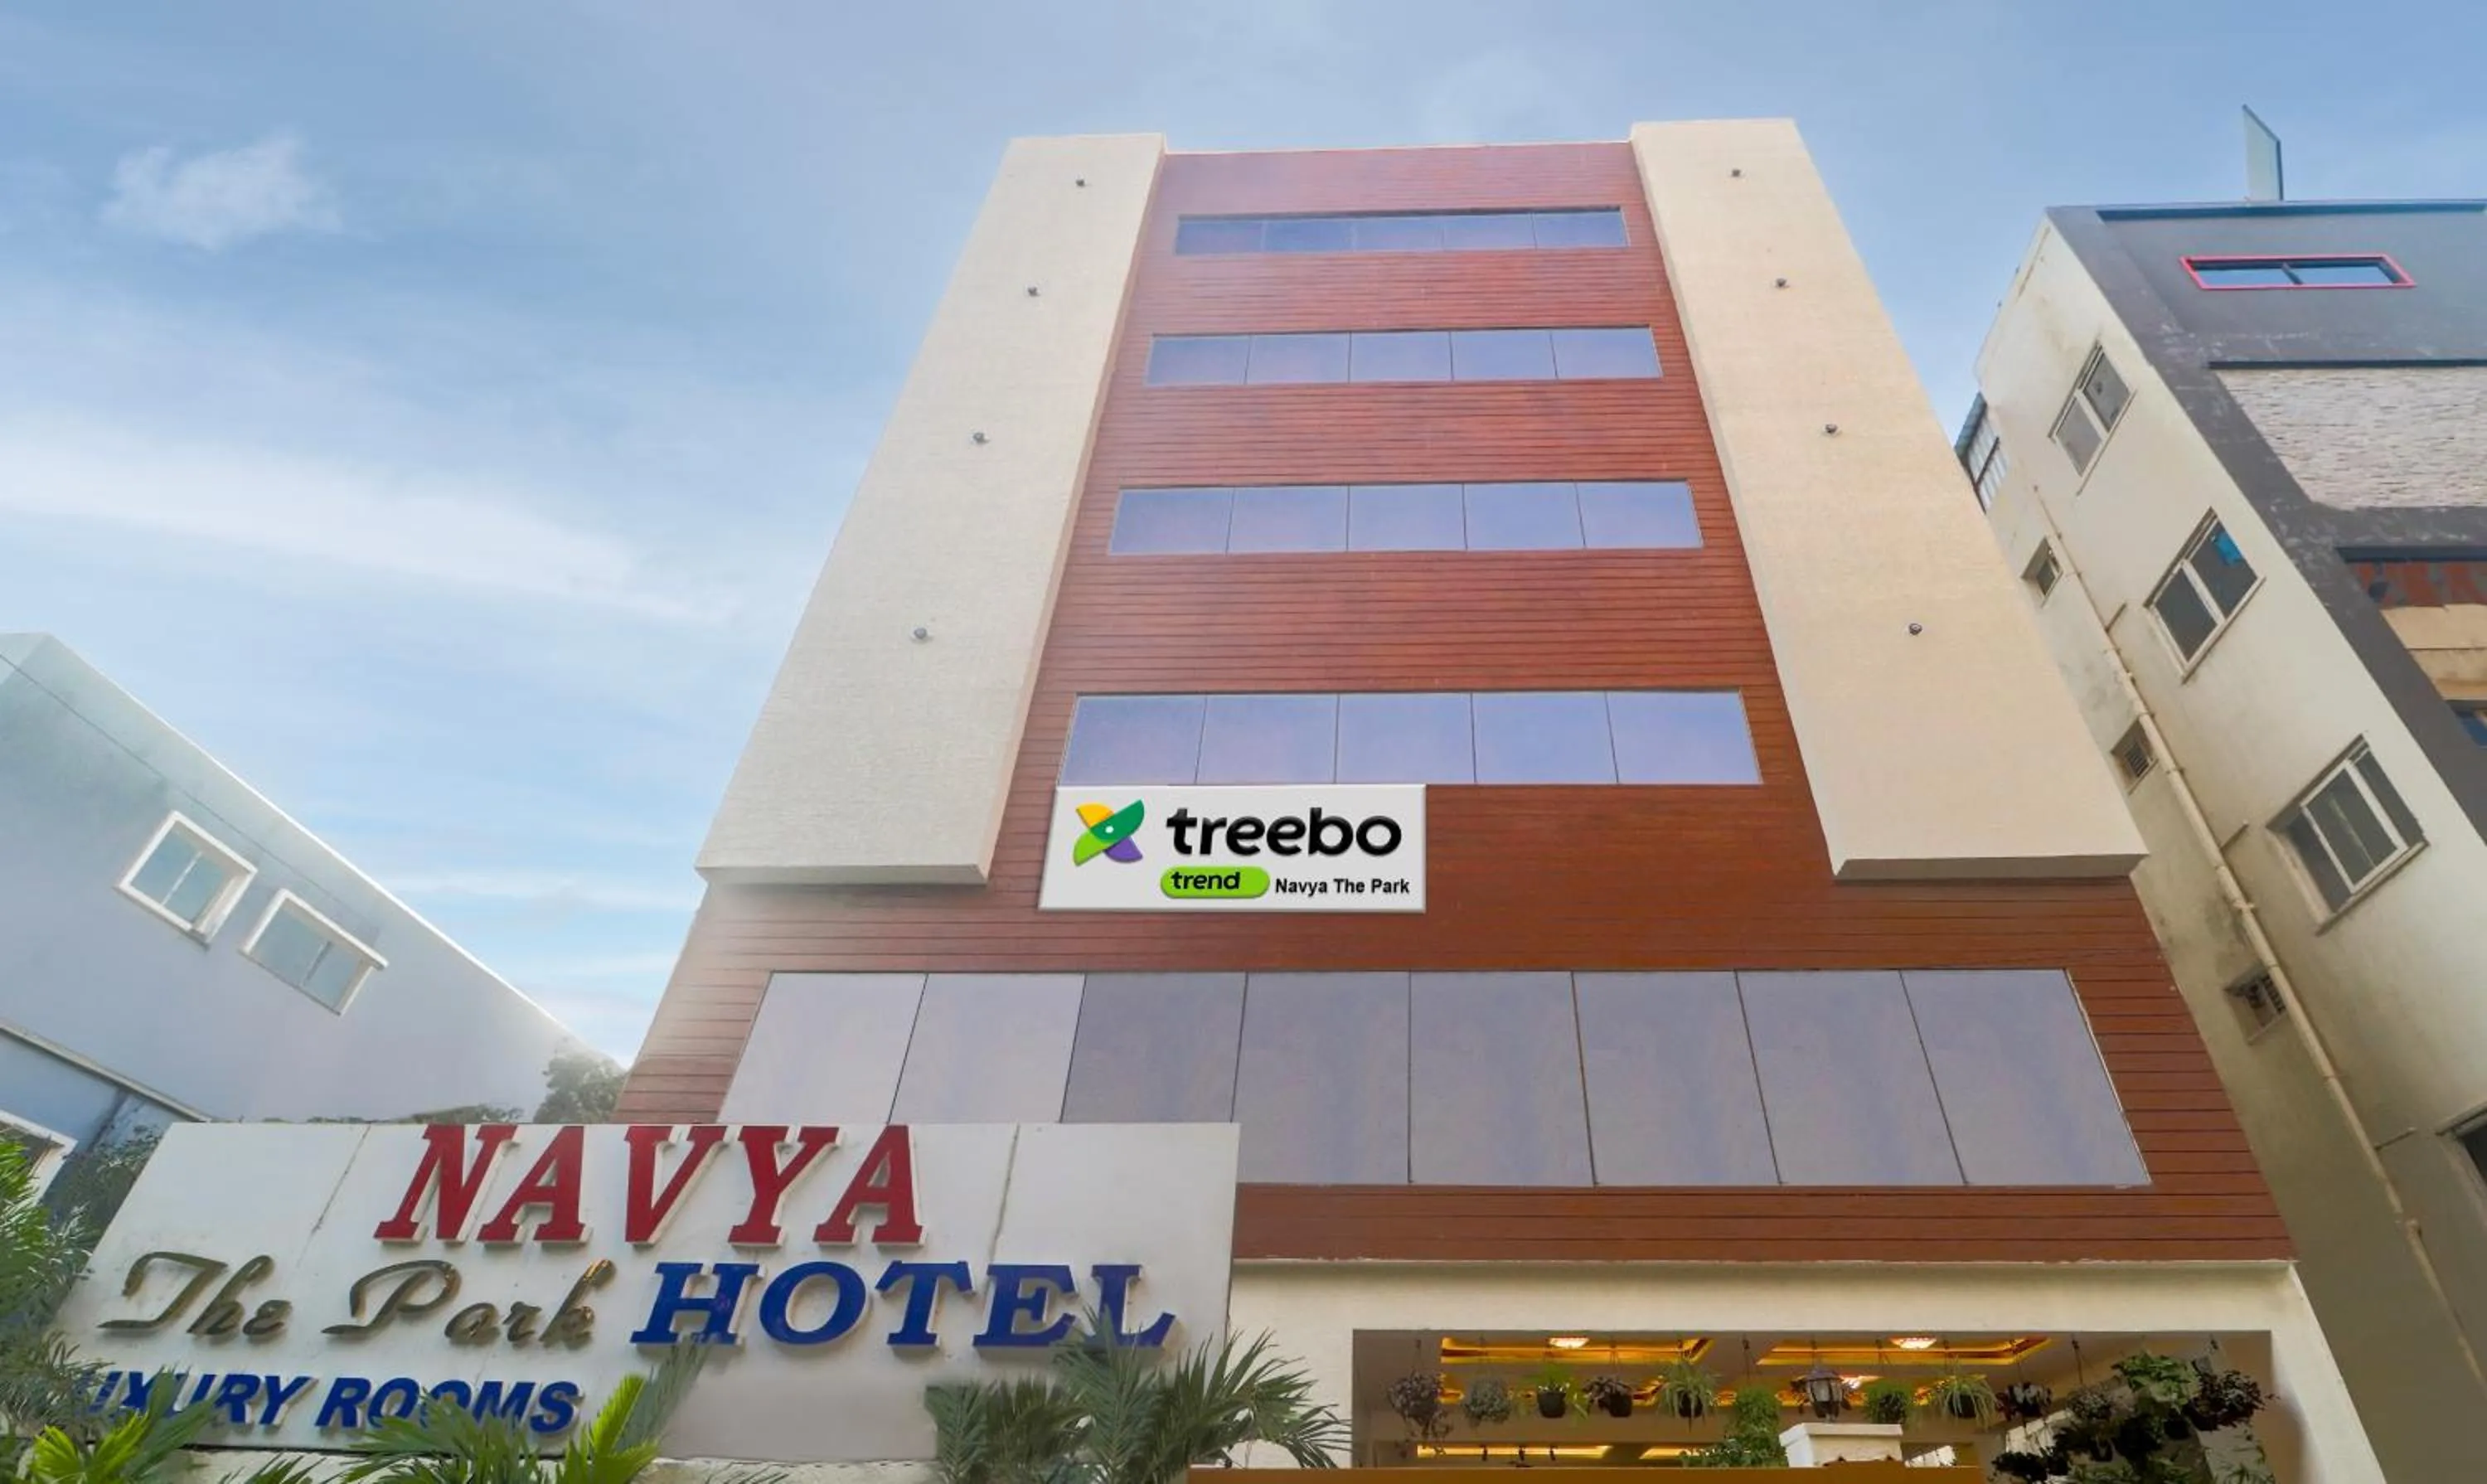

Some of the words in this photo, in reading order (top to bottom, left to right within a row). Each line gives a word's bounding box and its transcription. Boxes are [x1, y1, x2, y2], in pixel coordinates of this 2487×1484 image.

[1166, 807, 1402, 856] treebo
[1171, 871, 1240, 890] trend
[1275, 878, 1327, 897] Navya
[1333, 878, 1365, 894] The
[1371, 878, 1409, 894] Park
[374, 1124, 925, 1244] NAVYA
[96, 1251, 293, 1336] The
[322, 1258, 616, 1343] Park
[629, 1260, 1177, 1348] HOTEL
[70, 1370, 312, 1426] UXURY
